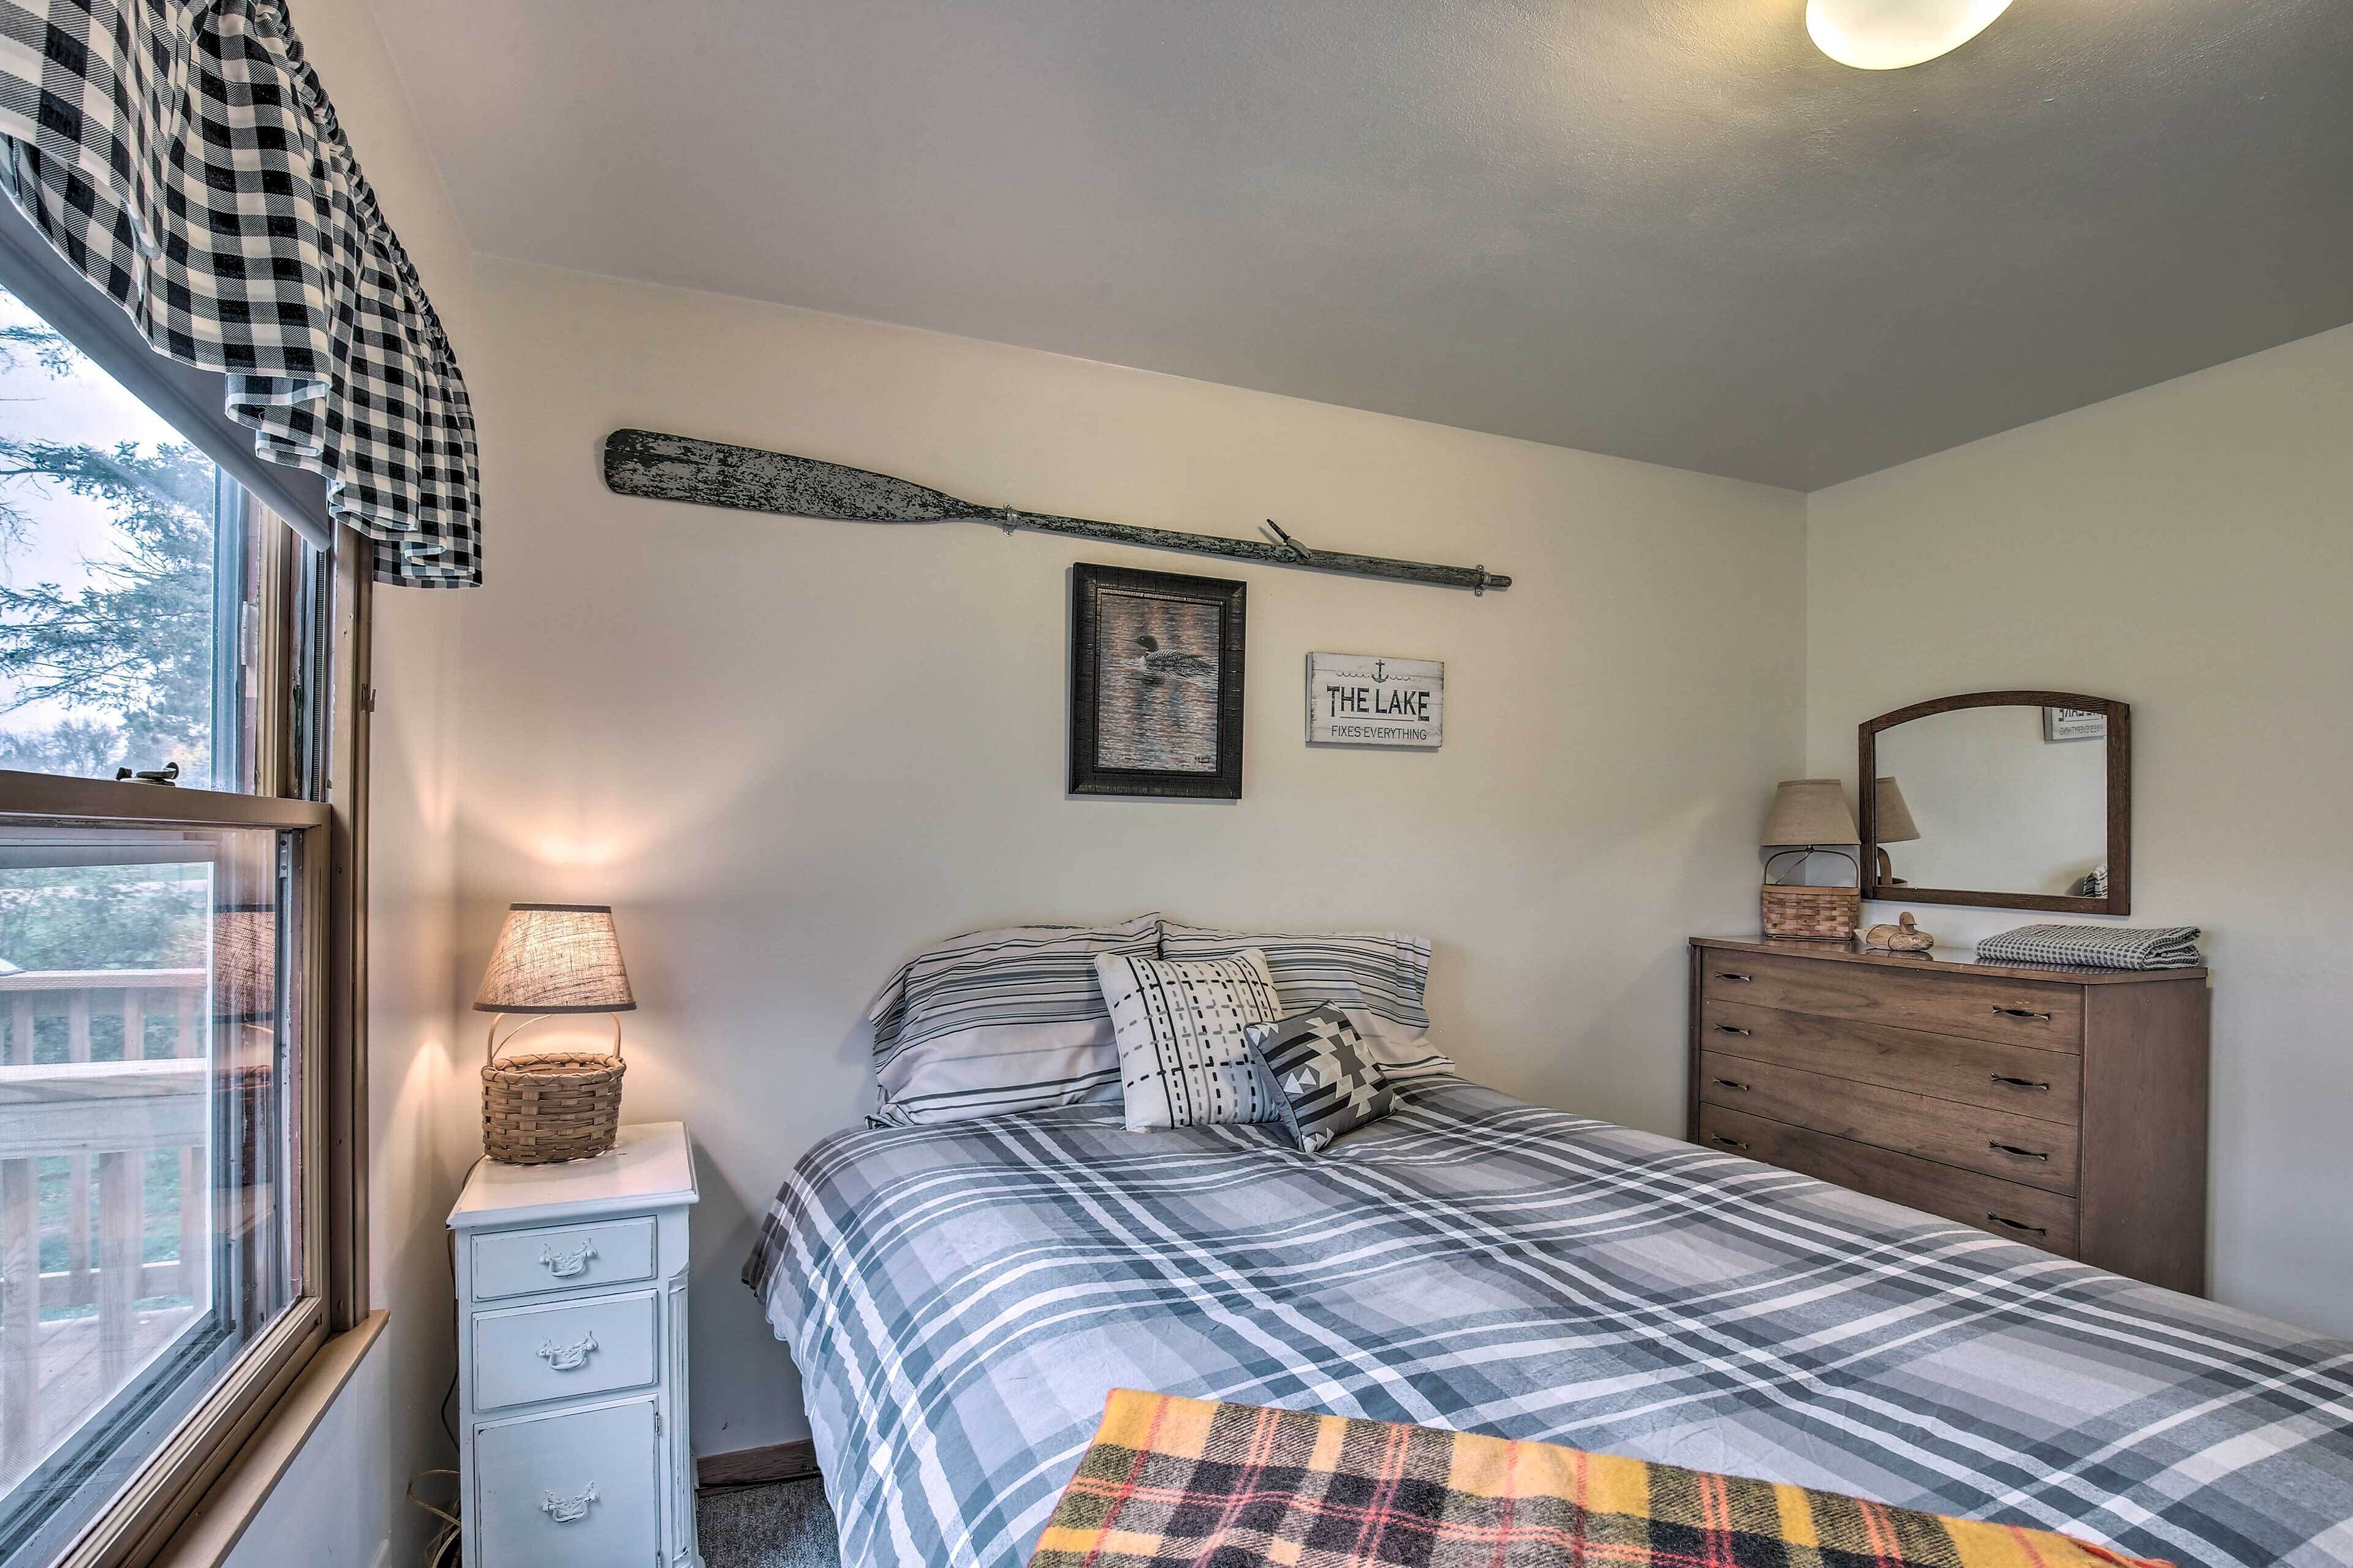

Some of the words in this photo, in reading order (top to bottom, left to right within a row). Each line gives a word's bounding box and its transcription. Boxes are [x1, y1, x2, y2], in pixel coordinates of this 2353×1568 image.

[1327, 684, 1370, 718] THE
[1376, 688, 1430, 722] LAKE
[1332, 725, 1361, 738] FIXES
[1364, 727, 1427, 740] EVERYTHING
